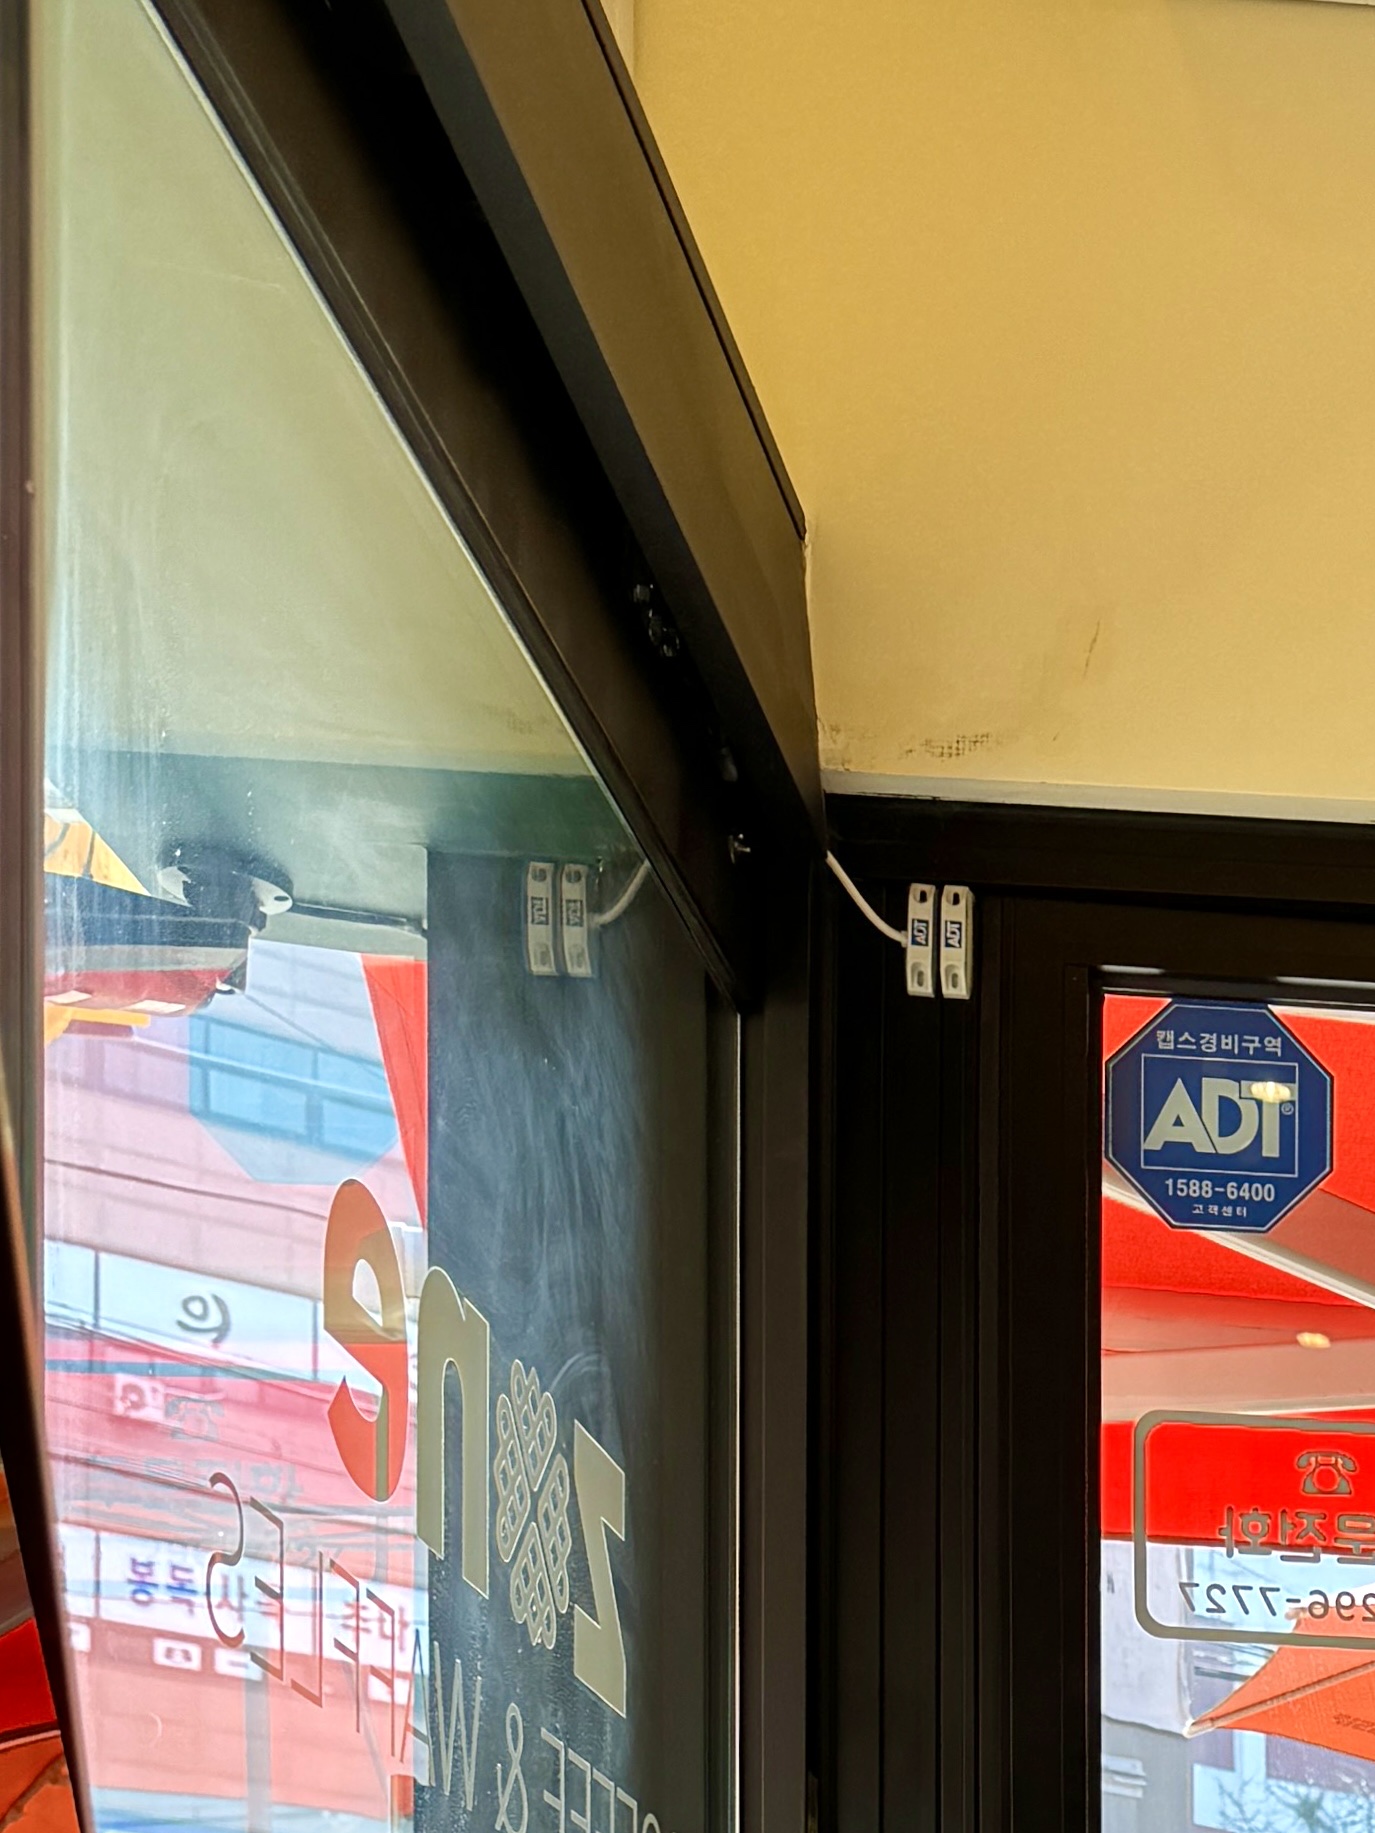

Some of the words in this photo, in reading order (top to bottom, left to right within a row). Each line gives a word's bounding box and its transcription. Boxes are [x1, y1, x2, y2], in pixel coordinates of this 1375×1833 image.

[1156, 1029, 1282, 1057] 캡스경비구역
[1144, 1077, 1298, 1158] ADT
[1164, 1178, 1276, 1202] 1588-6400
[1192, 1203, 1248, 1218] 고객센터
